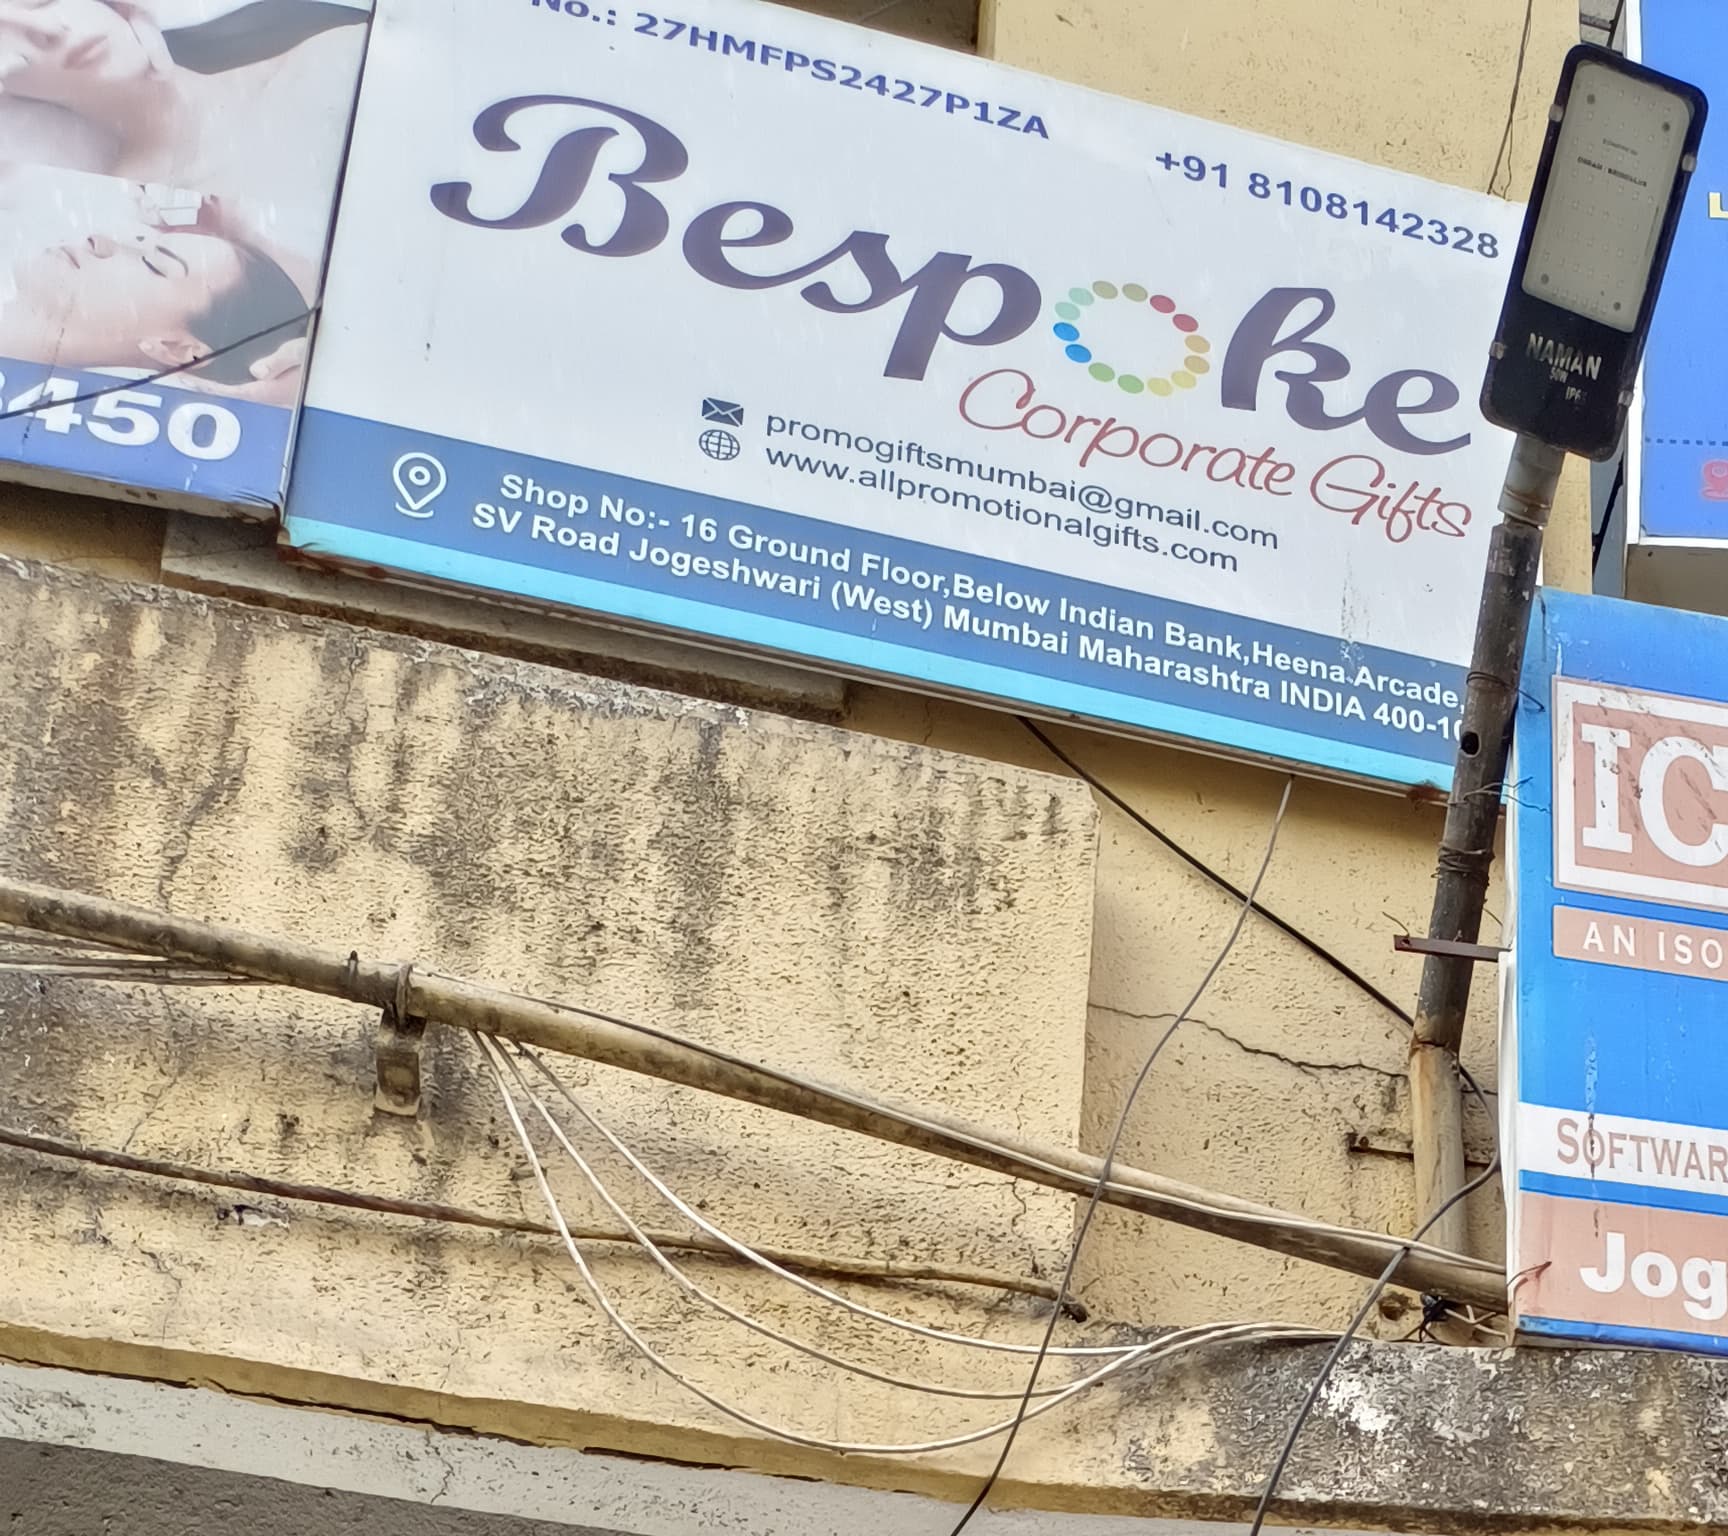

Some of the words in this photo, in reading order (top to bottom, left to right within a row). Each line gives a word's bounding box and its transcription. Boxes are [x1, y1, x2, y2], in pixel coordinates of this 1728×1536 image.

[633, 12, 1050, 140] 27HMFPS2427P1ZA
[1155, 150, 1231, 190] +91
[1246, 171, 1501, 260] 8108142328
[429, 92, 1473, 457] Bespoke
[0, 371, 242, 461] 450
[1525, 332, 1602, 381] NAMAN
[764, 443, 1240, 574] www.allpromotionalgifts.com
[765, 409, 1281, 552] promogiftsmumbai@gmail.com
[956, 367, 1297, 500] Corporate
[1308, 454, 1473, 544] Gifts
[472, 501, 523, 535] SV
[530, 514, 622, 558] Road
[628, 535, 823, 602] Jogeshwari
[830, 575, 935, 630] (West)
[943, 605, 1070, 656] Mumbai
[1078, 631, 1271, 700] Maharashtra
[1280, 680, 1367, 721] INDIA
[500, 473, 591, 519] Shop
[598, 495, 671, 531] No:-
[681, 513, 719, 544] 16
[728, 522, 851, 574] Ground
[860, 549, 1052, 621] Floor,Below
[1058, 595, 1156, 640] Indian
[1582, 922, 1637, 958] AN
[1658, 931, 1723, 969] ISO
